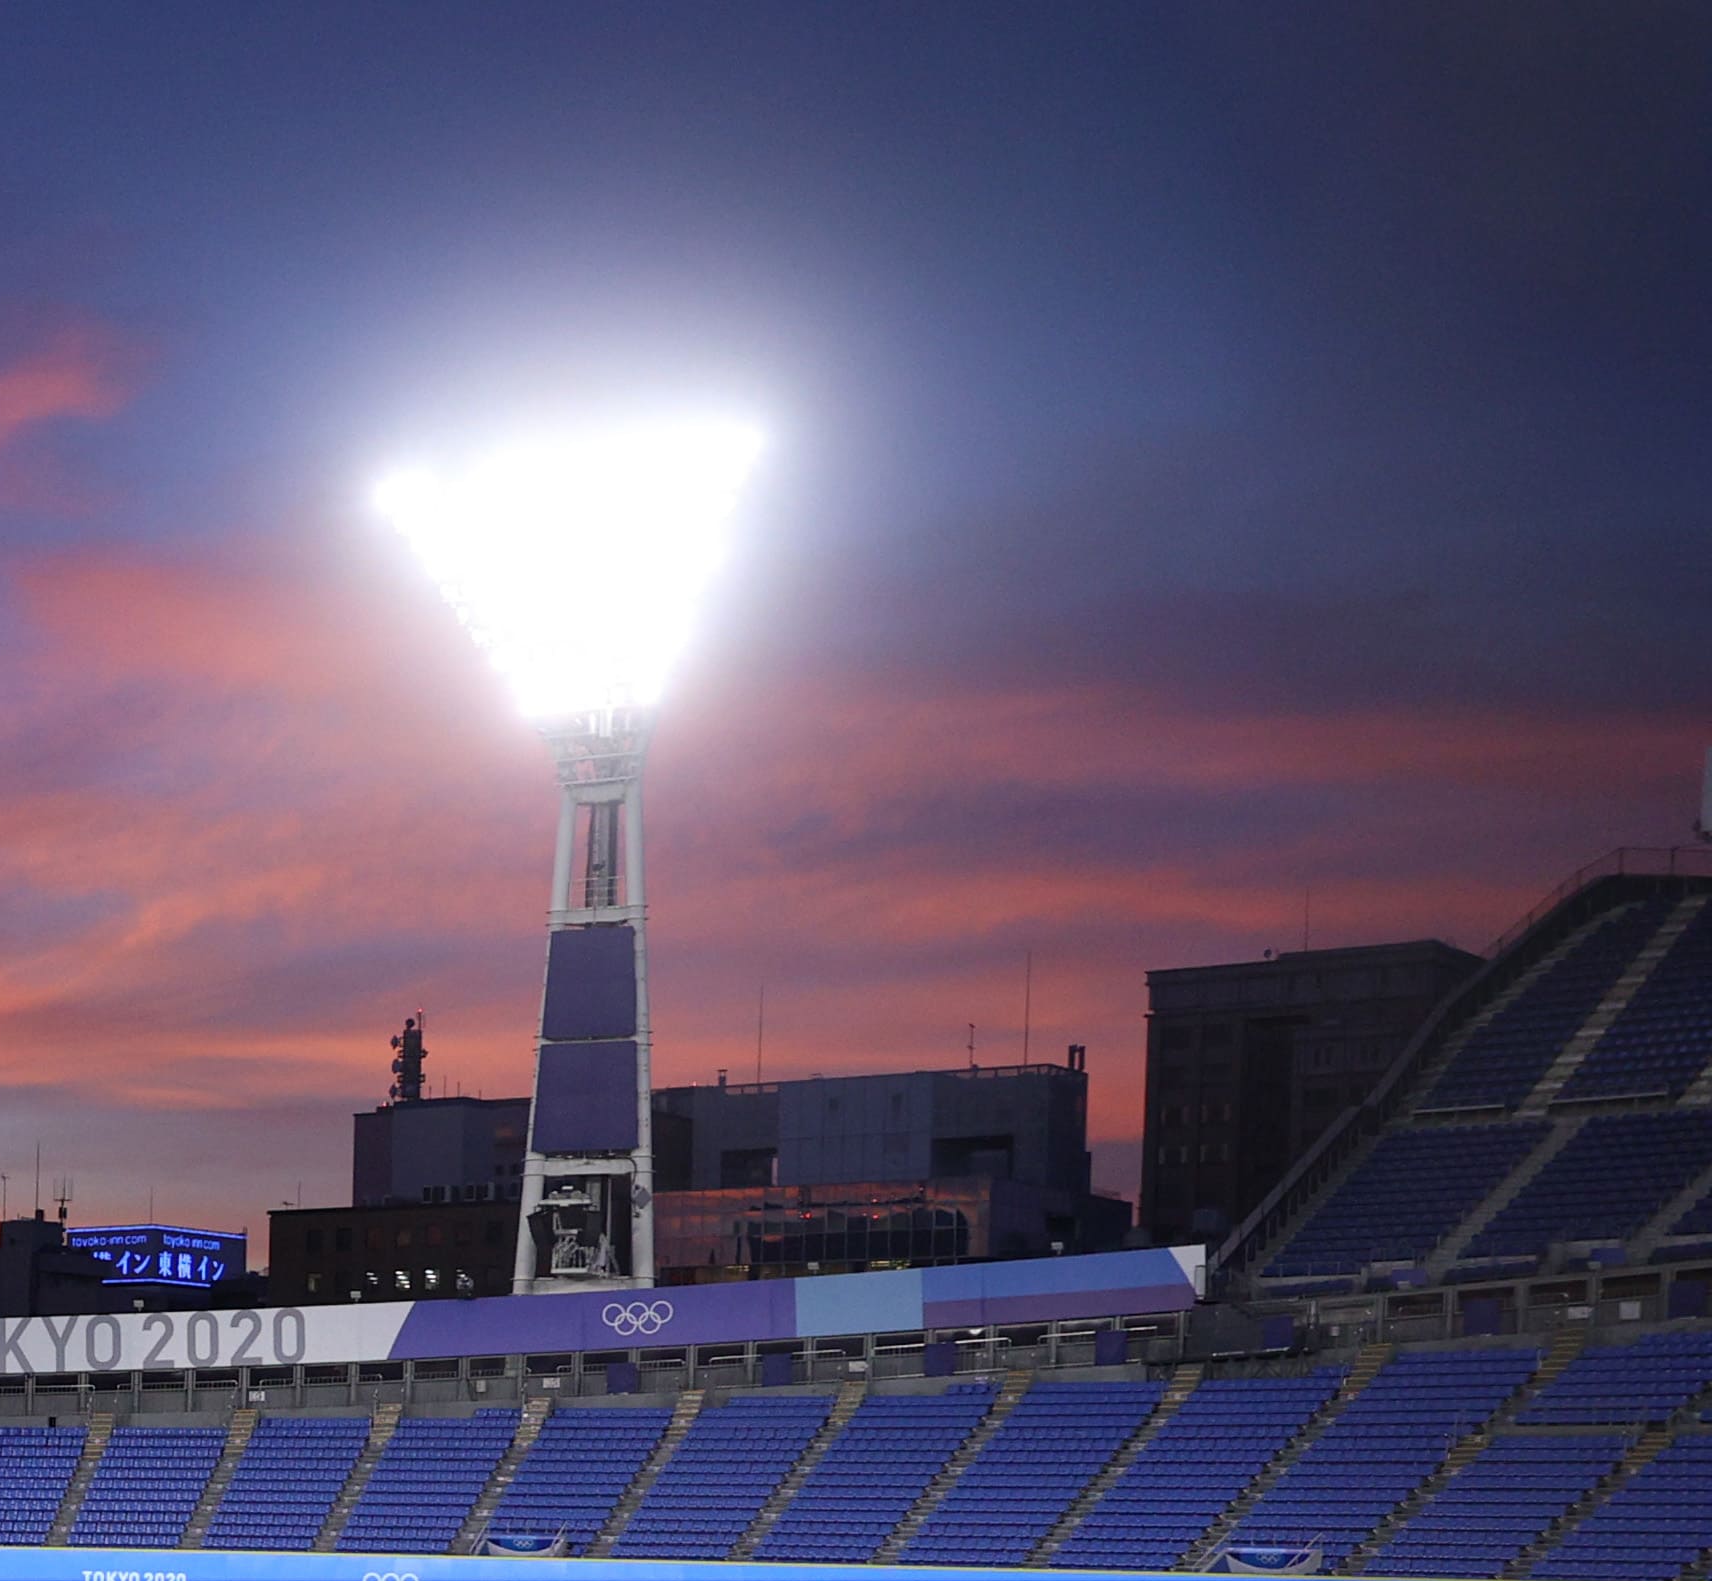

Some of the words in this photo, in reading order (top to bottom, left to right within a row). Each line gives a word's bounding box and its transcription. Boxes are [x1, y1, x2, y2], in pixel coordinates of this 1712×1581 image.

[158, 1251, 225, 1281] 東横イン
[142, 1308, 307, 1370] 2020
